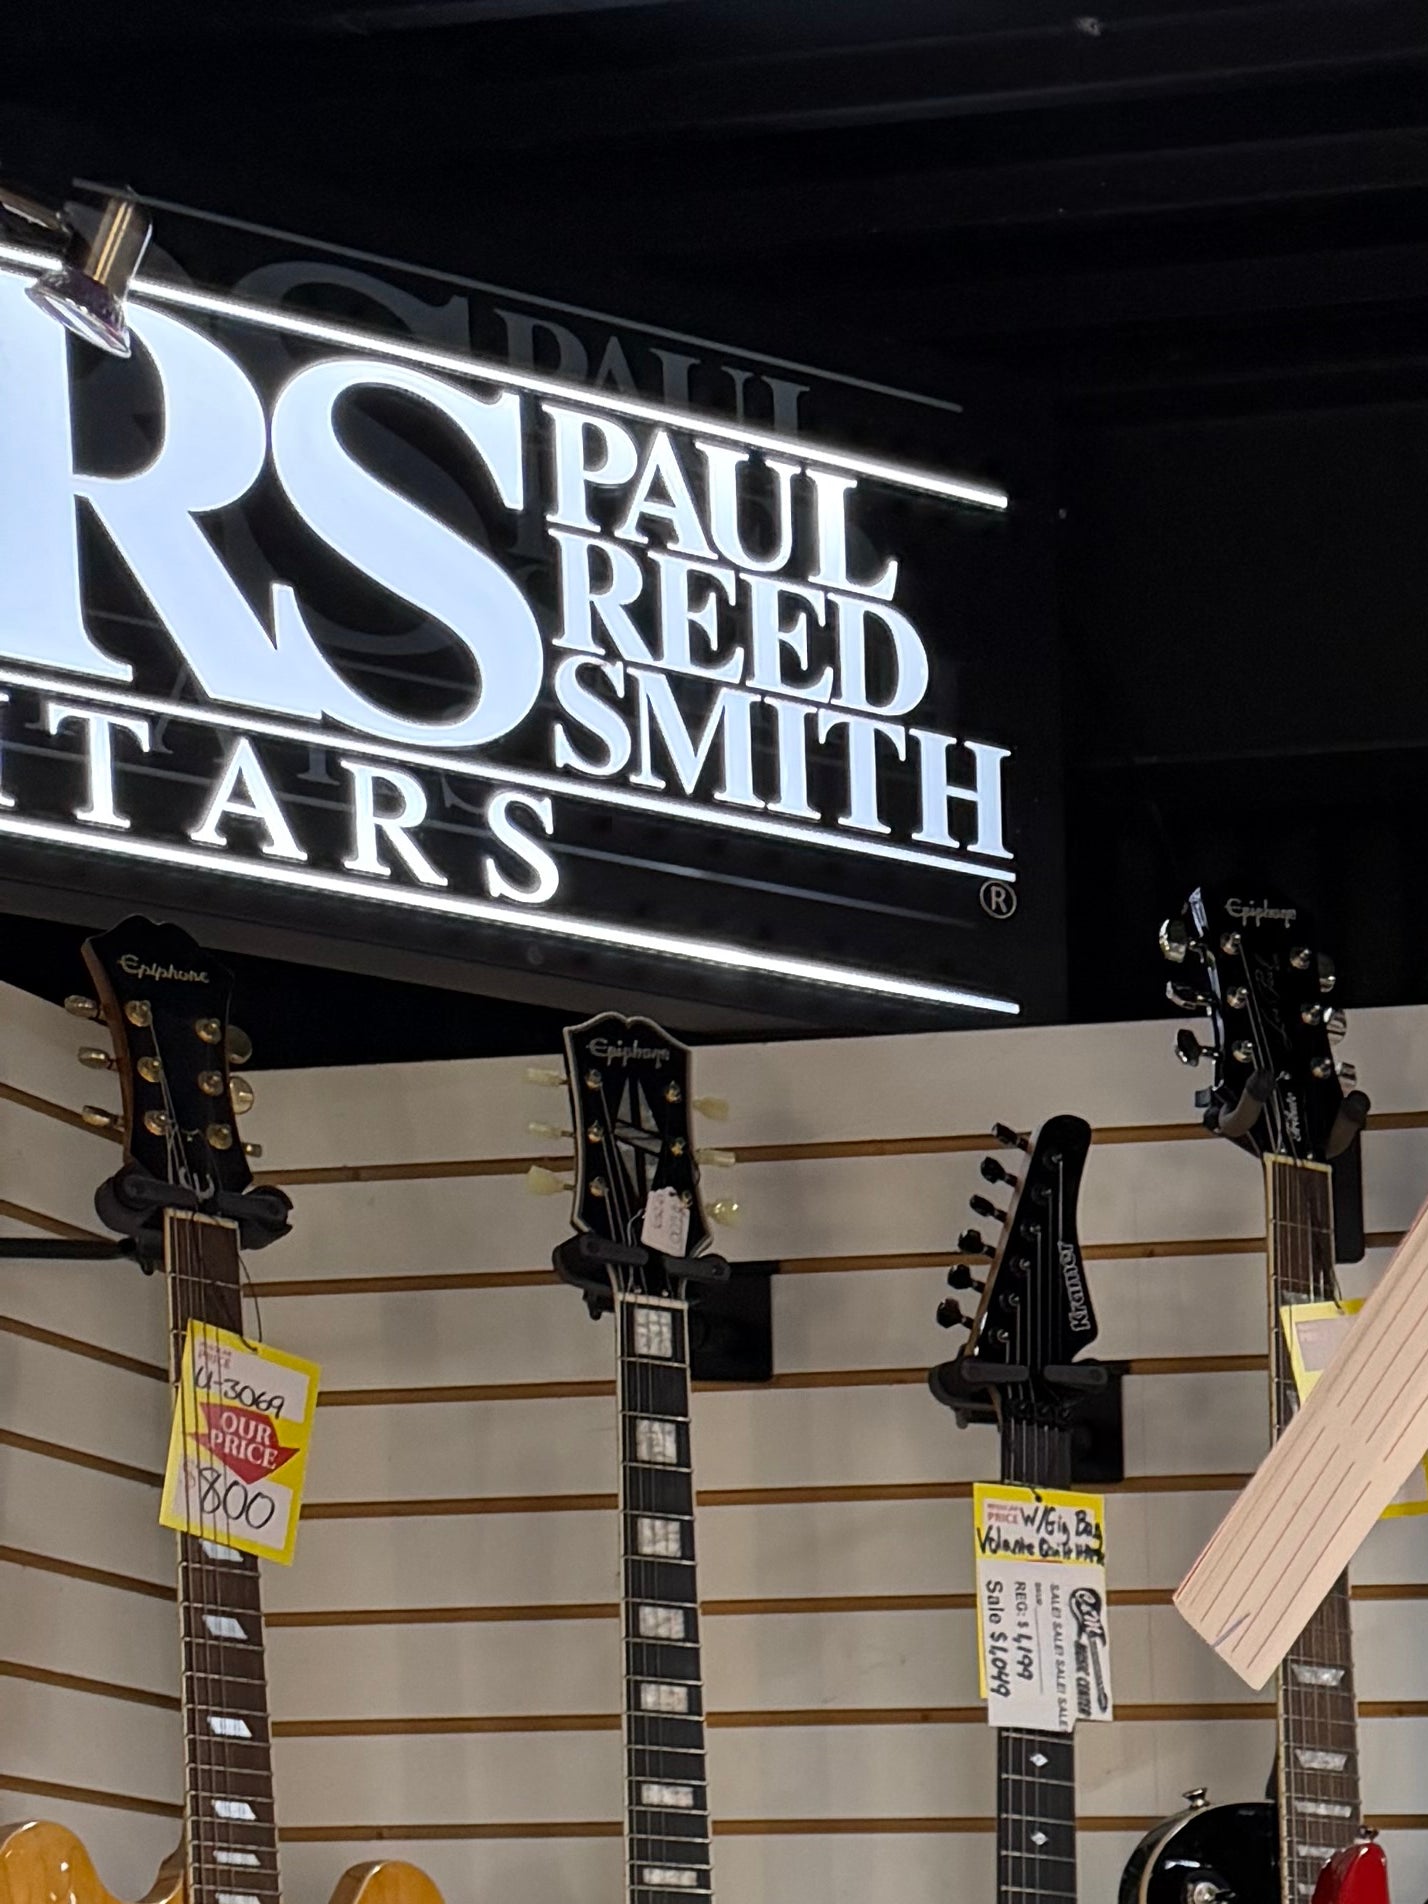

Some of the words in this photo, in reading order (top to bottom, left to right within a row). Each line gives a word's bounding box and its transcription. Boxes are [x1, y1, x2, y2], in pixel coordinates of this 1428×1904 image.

[541, 403, 900, 603] PAUL
[546, 526, 931, 719] REED
[550, 656, 1018, 861] SMITH
[0, 690, 561, 906] TARS
[1224, 897, 1297, 929] Epiphone
[117, 953, 210, 984] Epiphone
[586, 1037, 671, 1070] Epiphone
[1056, 1241, 1092, 1332] Kramer
[221, 1411, 273, 1446] OUR
[210, 1429, 279, 1471] PRICE
[987, 1510, 1019, 1525] PRICE
[985, 1579, 1004, 1626] Sale
[1013, 1580, 1028, 1618] REG:
[1049, 1583, 1061, 1620] SALE!
[1051, 1620, 1063, 1658] SALE!
[1054, 1658, 1067, 1697] SALE!
[1075, 1676, 1093, 1718] CENTER
